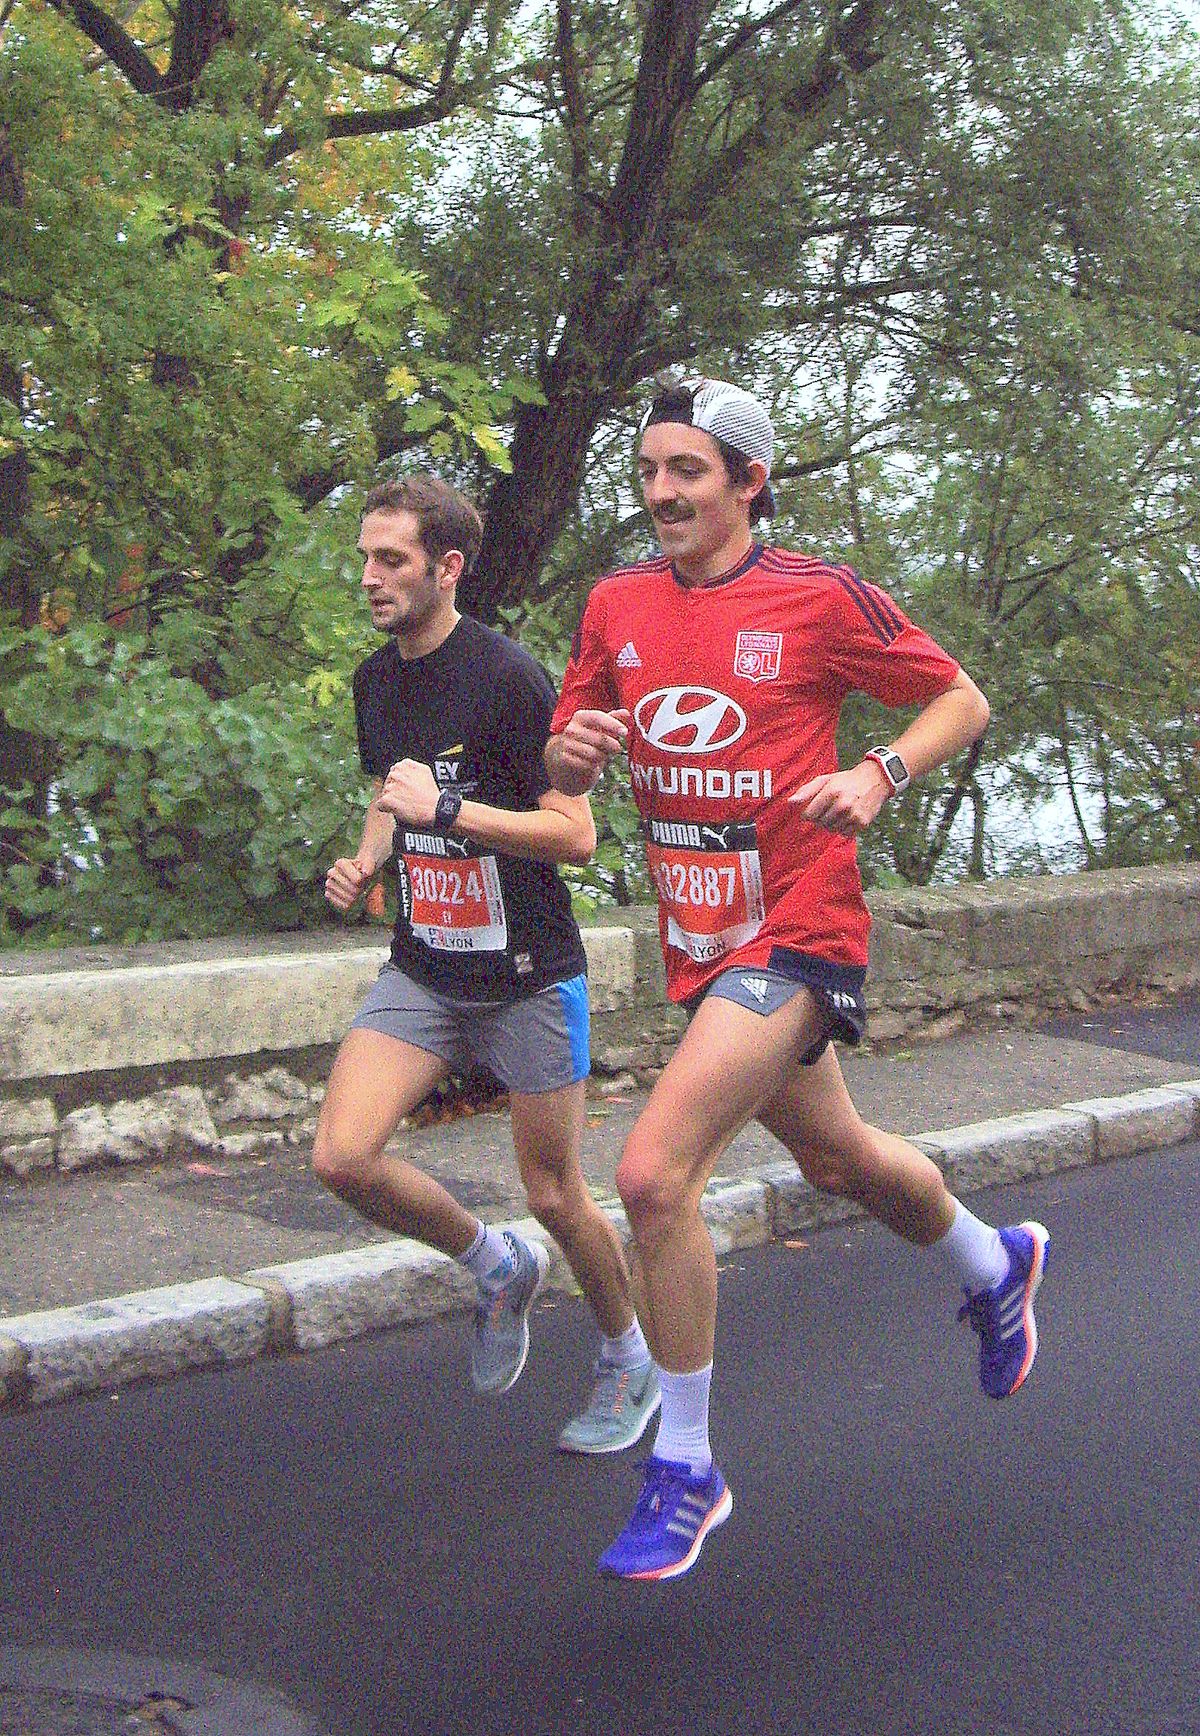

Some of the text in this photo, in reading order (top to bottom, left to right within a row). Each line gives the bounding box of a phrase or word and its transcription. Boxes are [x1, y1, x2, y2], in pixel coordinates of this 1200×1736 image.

[434, 760, 460, 780] EY
[630, 760, 772, 799] HYUNDAI
[405, 832, 446, 856] PUMA
[651, 820, 701, 847] PUMA
[411, 866, 483, 904] 30224
[446, 938, 474, 948] LYON
